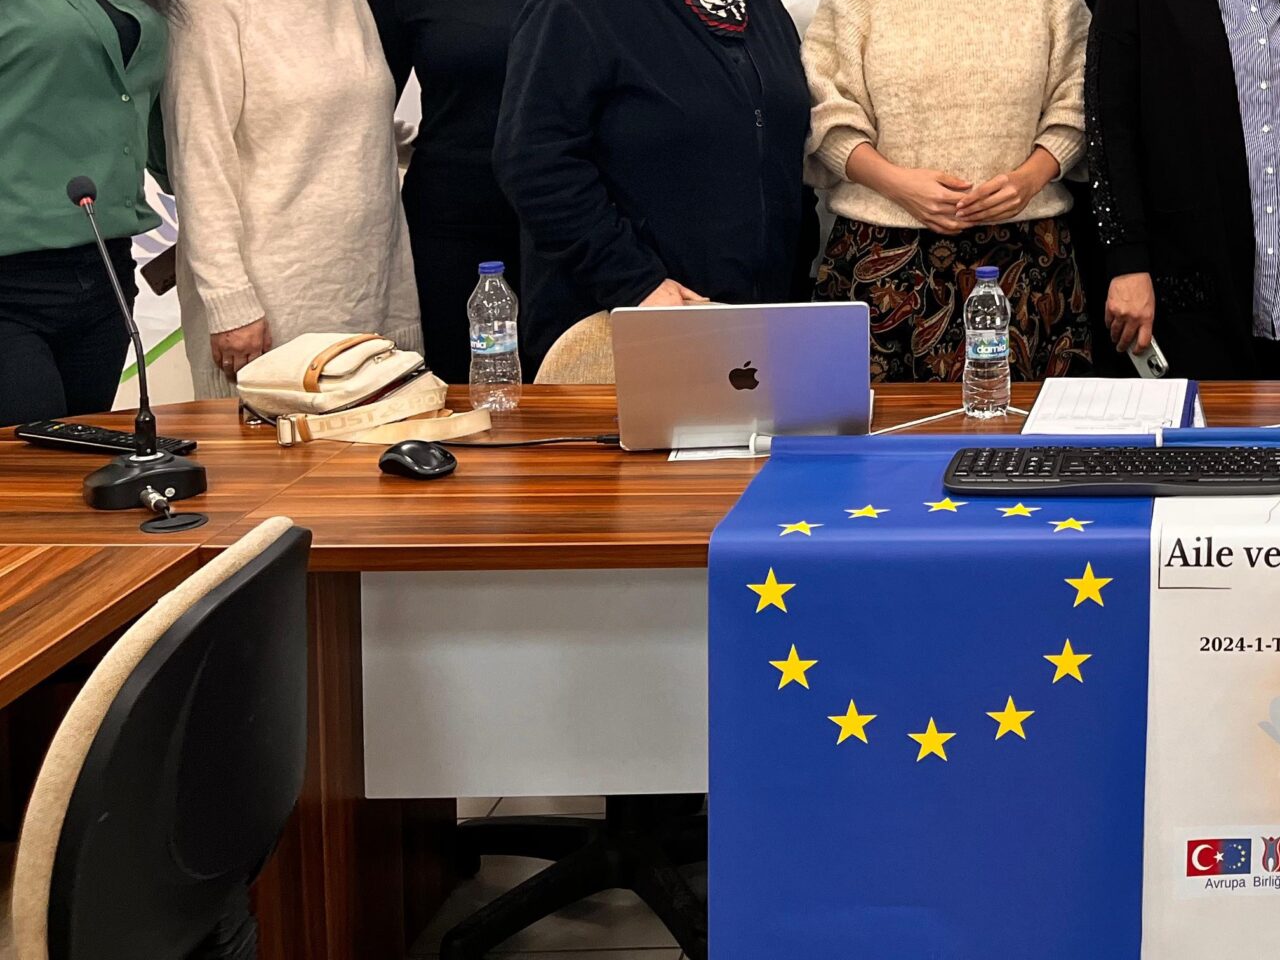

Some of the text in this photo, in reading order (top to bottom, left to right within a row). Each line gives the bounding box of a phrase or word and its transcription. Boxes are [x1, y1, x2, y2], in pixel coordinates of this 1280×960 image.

[976, 343, 1006, 354] damla
[1164, 536, 1234, 568] Aile
[1205, 878, 1246, 890] Avrupa
